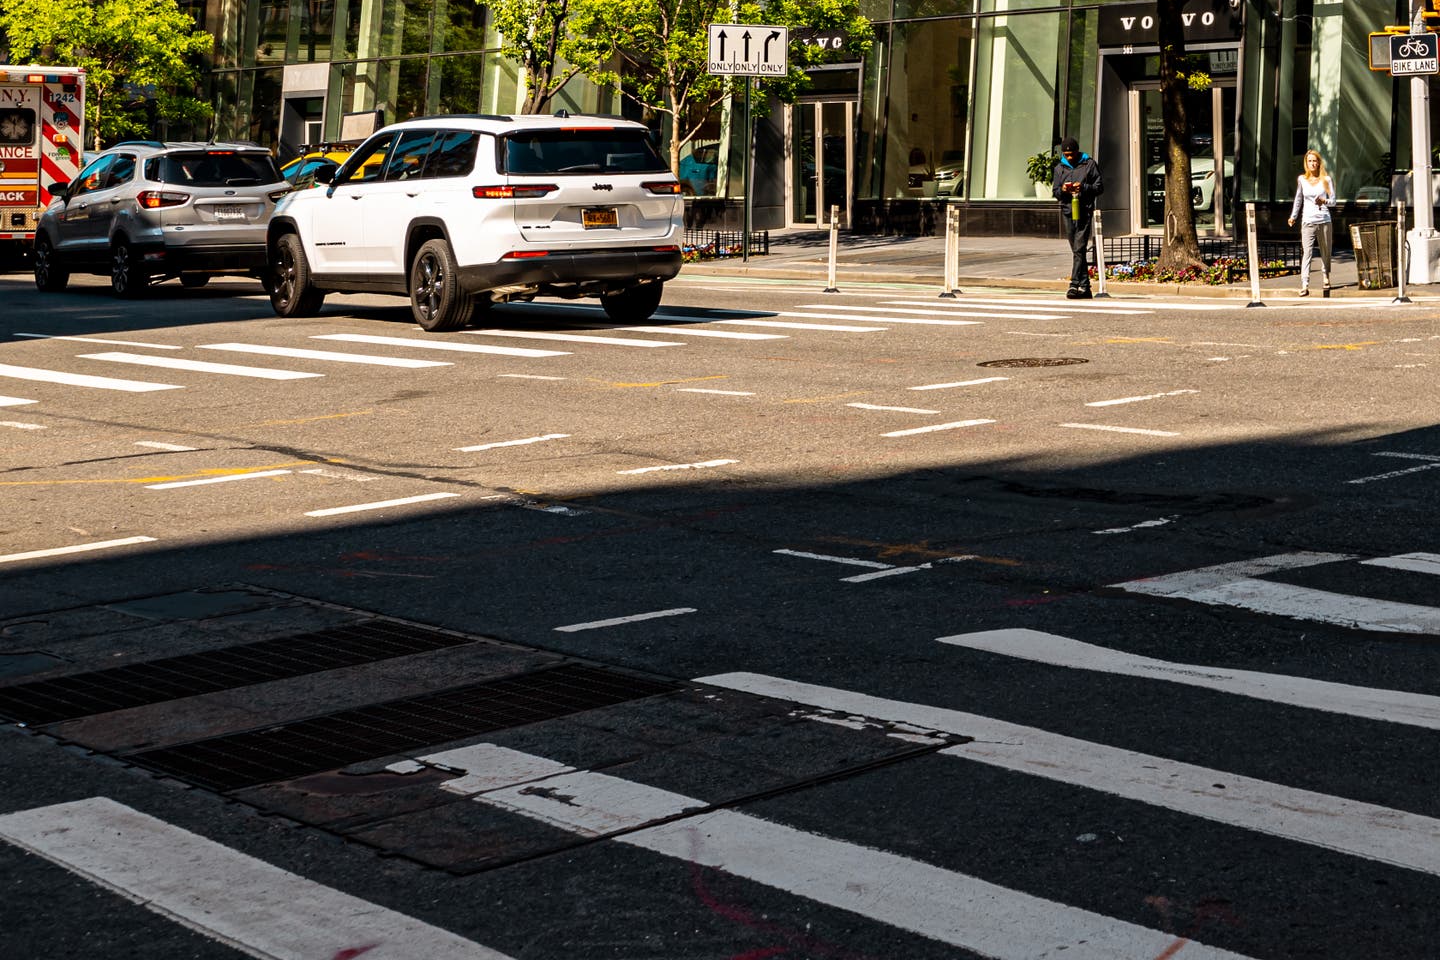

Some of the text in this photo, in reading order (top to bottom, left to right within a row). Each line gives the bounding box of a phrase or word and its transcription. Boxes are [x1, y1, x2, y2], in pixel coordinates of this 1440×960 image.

[1120, 12, 1215, 30] VOVO
[710, 62, 733, 71] ONLY
[735, 63, 757, 72] ONLY
[760, 64, 783, 72] ONLY
[1393, 60, 1436, 71] BIKE LANE
[49, 93, 75, 103] 1242
[592, 183, 613, 192] Jeep
